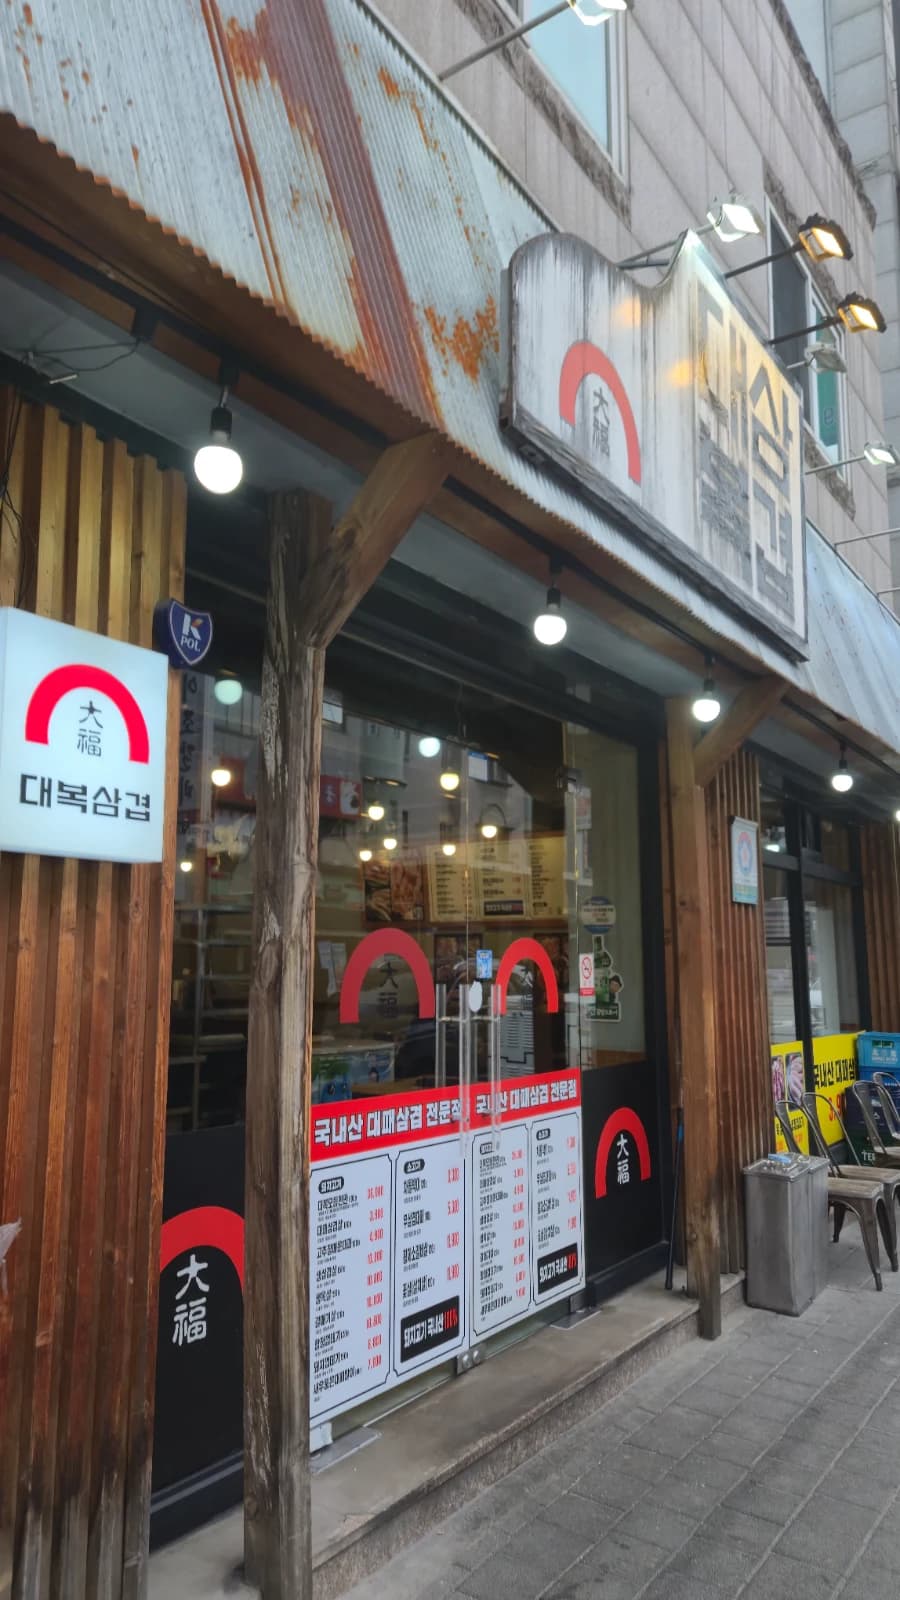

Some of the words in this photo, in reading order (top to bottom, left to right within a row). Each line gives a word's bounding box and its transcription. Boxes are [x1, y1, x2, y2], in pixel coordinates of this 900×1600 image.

[180, 636, 202, 652] POL
[77, 700, 104, 758] 大福
[19, 773, 151, 822] 대복삼겹
[836, 1058, 857, 1083] 대패삼
[510, 1083, 549, 1111] 대패삼겹
[550, 1079, 577, 1103] 전문점
[314, 1113, 364, 1147] 국내산
[367, 1104, 423, 1138] 대패삼겹
[426, 1099, 463, 1128] 전문점
[616, 1133, 631, 1185] 大福
[171, 1253, 210, 1347] 大福
[403, 1325, 427, 1349] 돼지고기
[427, 1312, 444, 1338] 국내산
